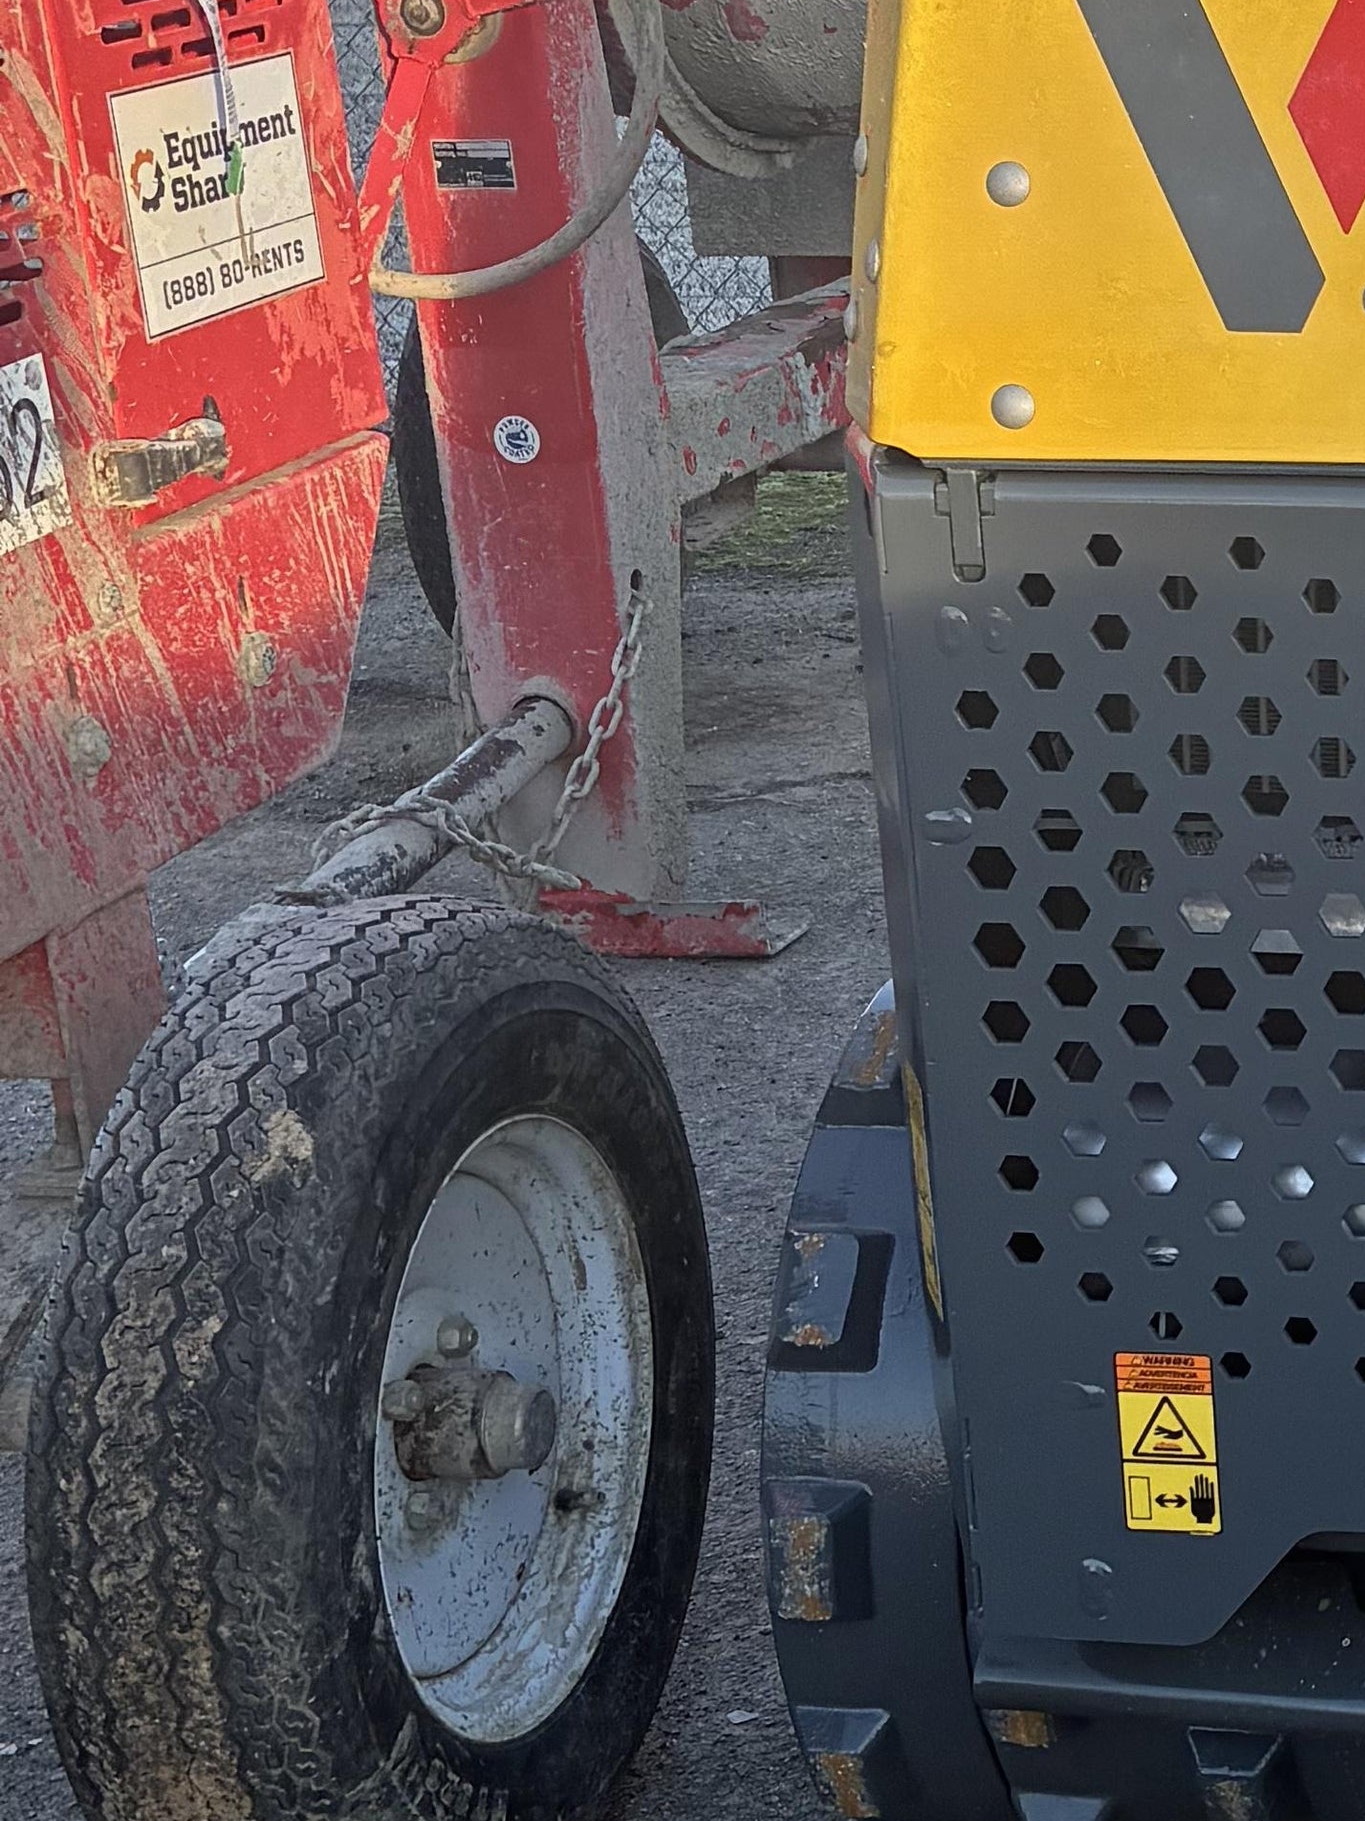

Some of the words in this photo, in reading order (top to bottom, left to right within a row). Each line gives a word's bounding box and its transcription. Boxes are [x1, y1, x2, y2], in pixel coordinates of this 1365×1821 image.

[171, 171, 236, 214] Shar
[162, 266, 215, 310] (888)
[219, 238, 305, 289] 80-RENTS
[1142, 1355, 1195, 1367] WARNING
